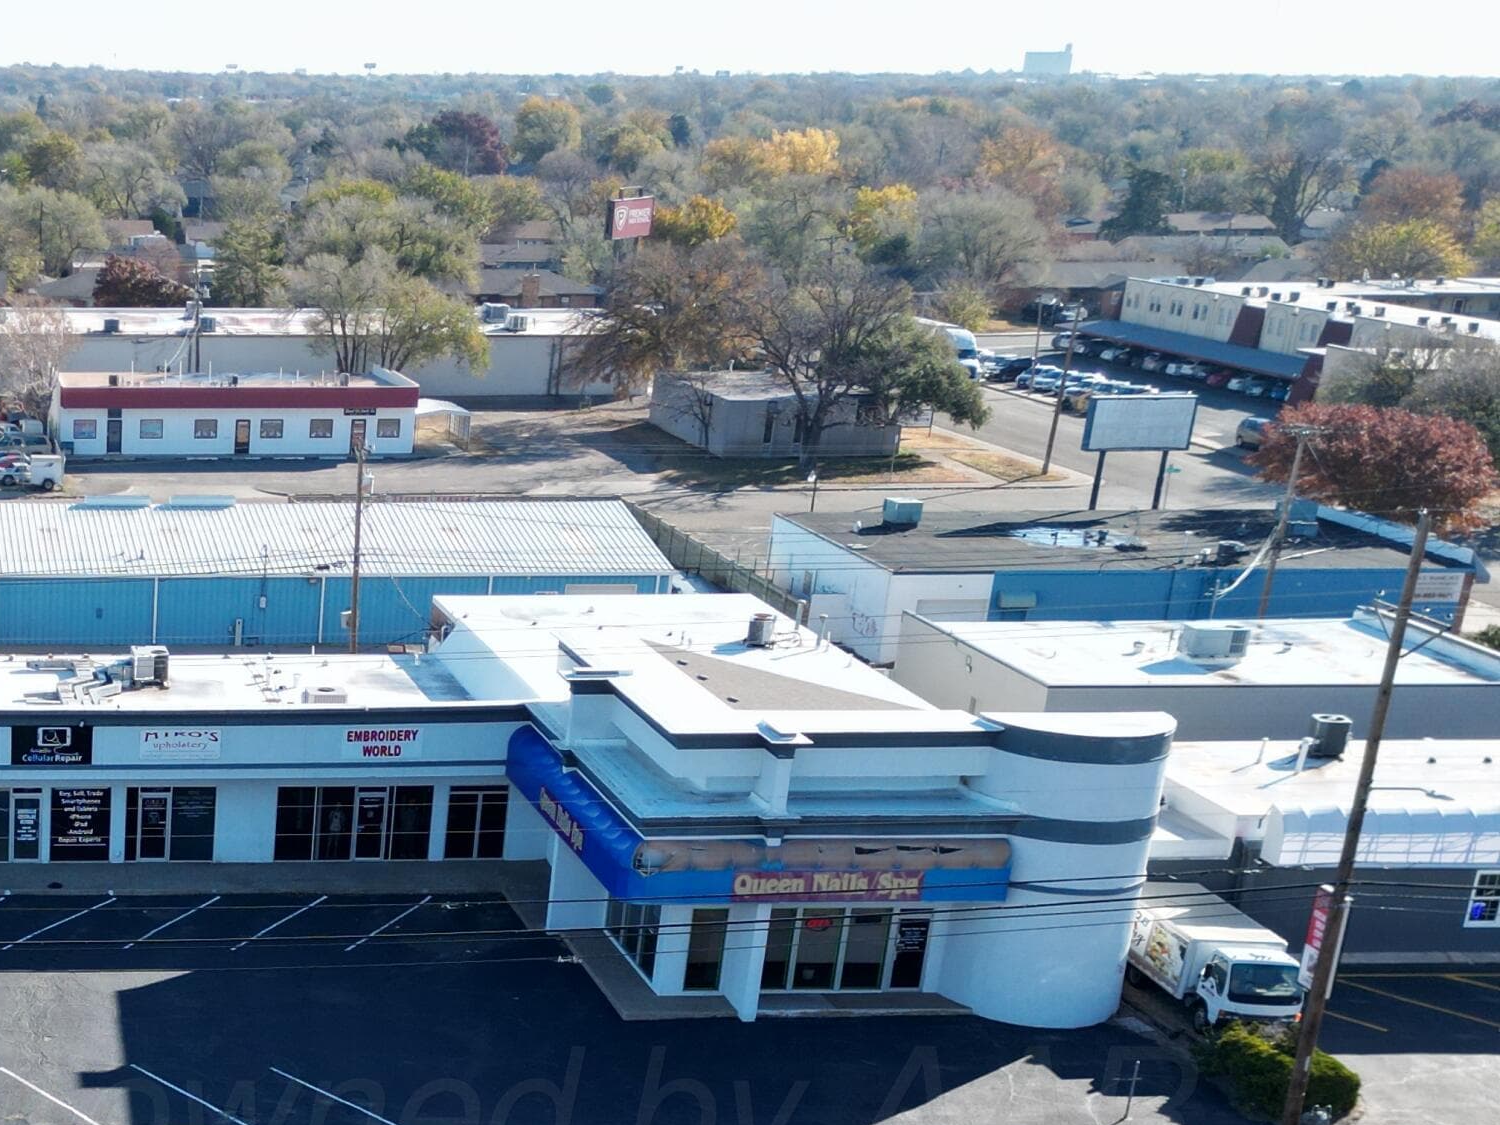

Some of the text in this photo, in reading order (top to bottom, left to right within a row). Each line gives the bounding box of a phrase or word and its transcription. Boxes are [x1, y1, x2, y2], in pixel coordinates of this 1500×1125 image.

[144, 730, 219, 743] MIKO'S
[346, 729, 419, 742] EMBROIDERY
[362, 745, 402, 757] WORLD
[22, 753, 83, 763] Cellular Repair
[733, 871, 919, 900] Queen Nails Spa
